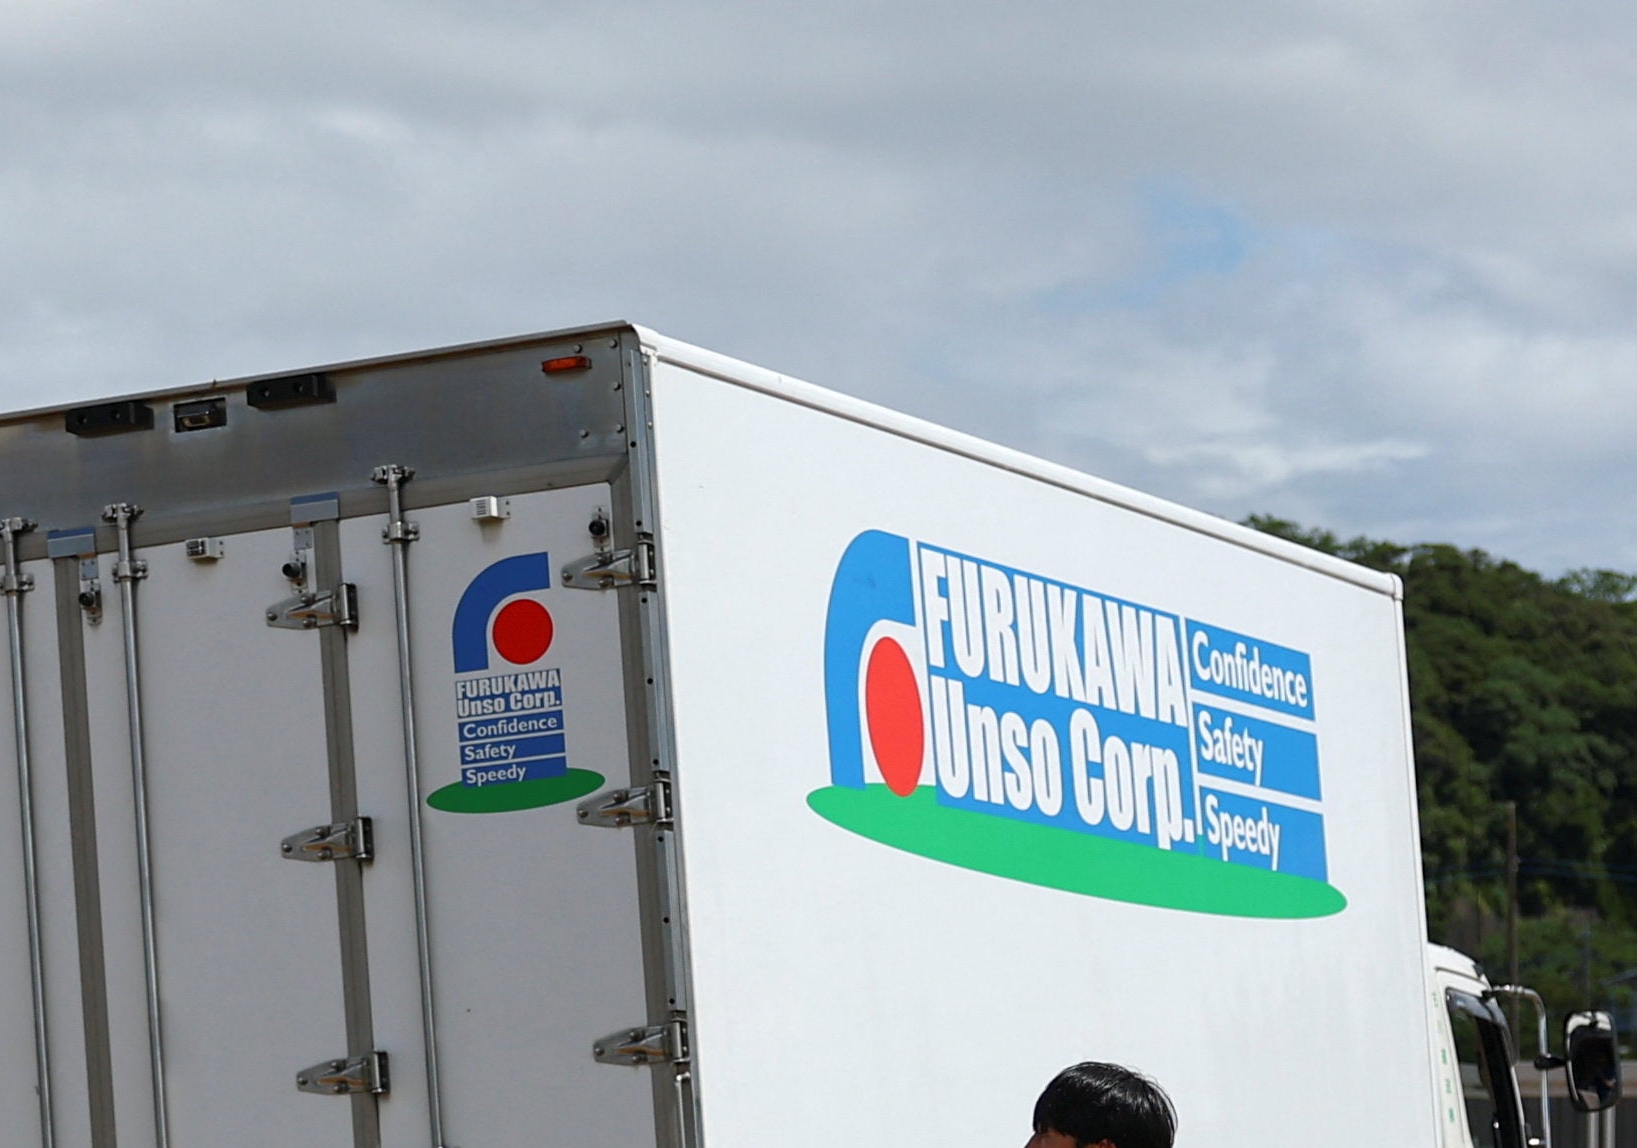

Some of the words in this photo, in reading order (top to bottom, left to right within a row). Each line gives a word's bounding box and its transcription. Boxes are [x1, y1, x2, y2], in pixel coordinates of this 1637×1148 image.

[919, 547, 1188, 728] FURUKAWA
[456, 670, 561, 699] FURUKAWA
[1193, 630, 1308, 708] Confidence
[457, 697, 505, 717] Unso
[509, 690, 561, 710] Corp.
[463, 717, 558, 739] Confidence
[464, 743, 516, 761] Safety
[930, 674, 1062, 816] Unso
[1069, 707, 1196, 850] Corp.
[1199, 709, 1264, 786] Safety
[466, 764, 527, 787] Speedy
[1205, 793, 1280, 872] Speedy
